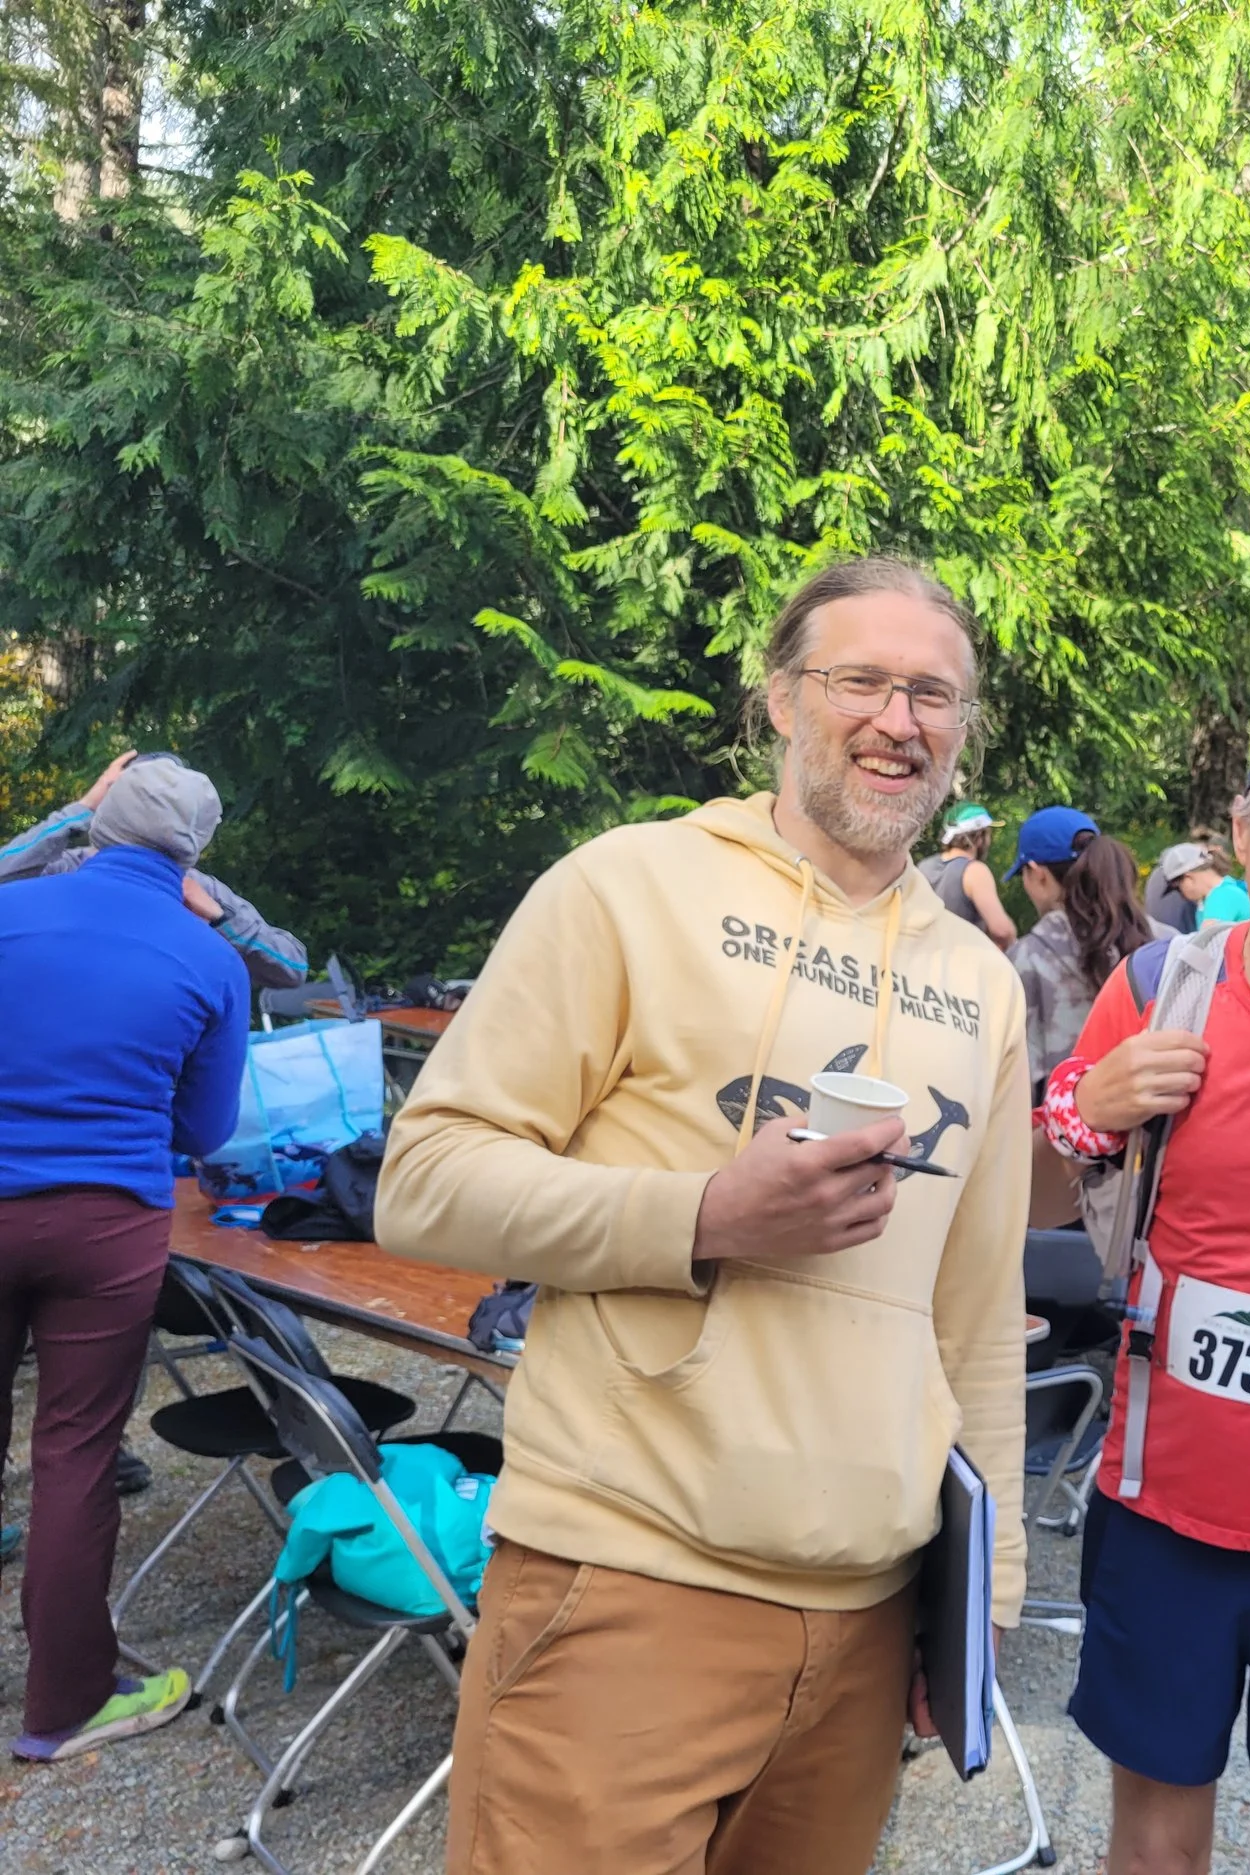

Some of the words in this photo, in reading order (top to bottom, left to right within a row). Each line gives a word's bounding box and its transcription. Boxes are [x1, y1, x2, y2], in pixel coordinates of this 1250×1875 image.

[722, 915, 861, 981] ORCAS
[722, 939, 776, 968] ONE
[790, 960, 879, 1008] HUNDRE
[900, 996, 947, 1025] MILE
